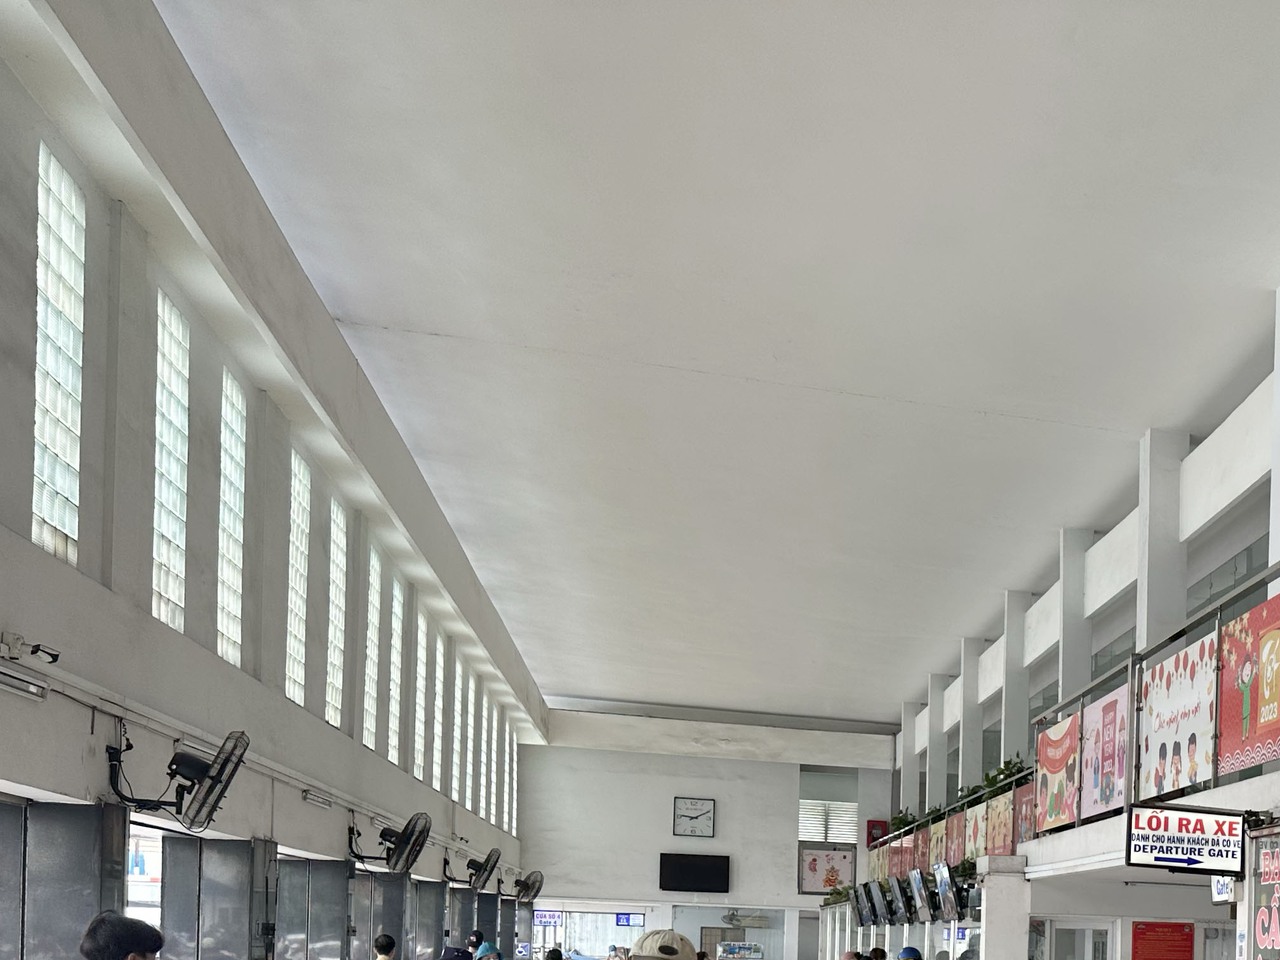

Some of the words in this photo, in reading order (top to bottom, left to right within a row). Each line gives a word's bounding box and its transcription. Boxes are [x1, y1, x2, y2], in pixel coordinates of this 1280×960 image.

[1260, 702, 1278, 723] 2023
[1104, 723, 1115, 741] NEW
[1134, 809, 1169, 832] LỐI
[1178, 817, 1205, 835] RA
[1213, 819, 1240, 837] XE
[1152, 834, 1165, 843] CHO
[1133, 844, 1204, 857] DEPARTURE
[1208, 848, 1238, 859] GATE
